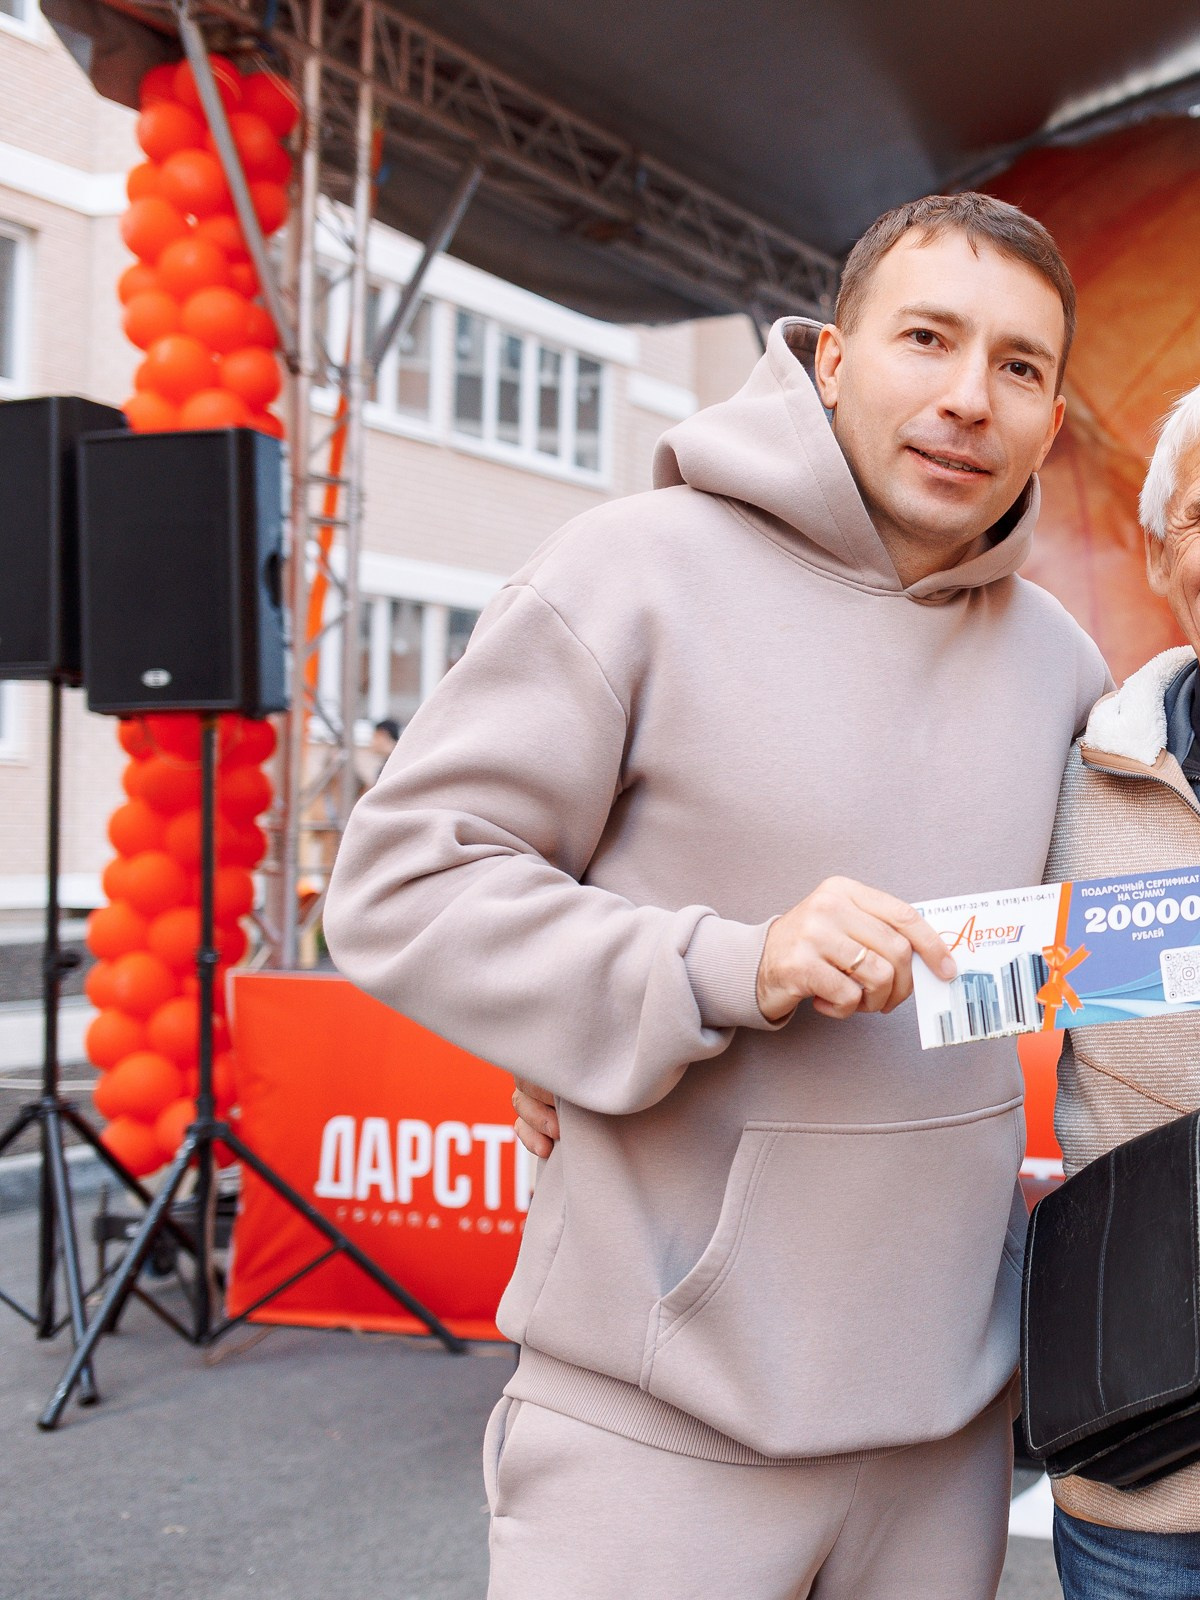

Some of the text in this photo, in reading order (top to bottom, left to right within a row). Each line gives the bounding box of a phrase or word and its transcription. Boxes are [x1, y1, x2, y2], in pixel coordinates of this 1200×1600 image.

[1081, 875, 1200, 897] ПОДАРОЧНЫЙ СЕРТИФИКАТ
[1117, 888, 1166, 902] НА СУММУ
[1131, 927, 1165, 941] РУБЛЕЙ
